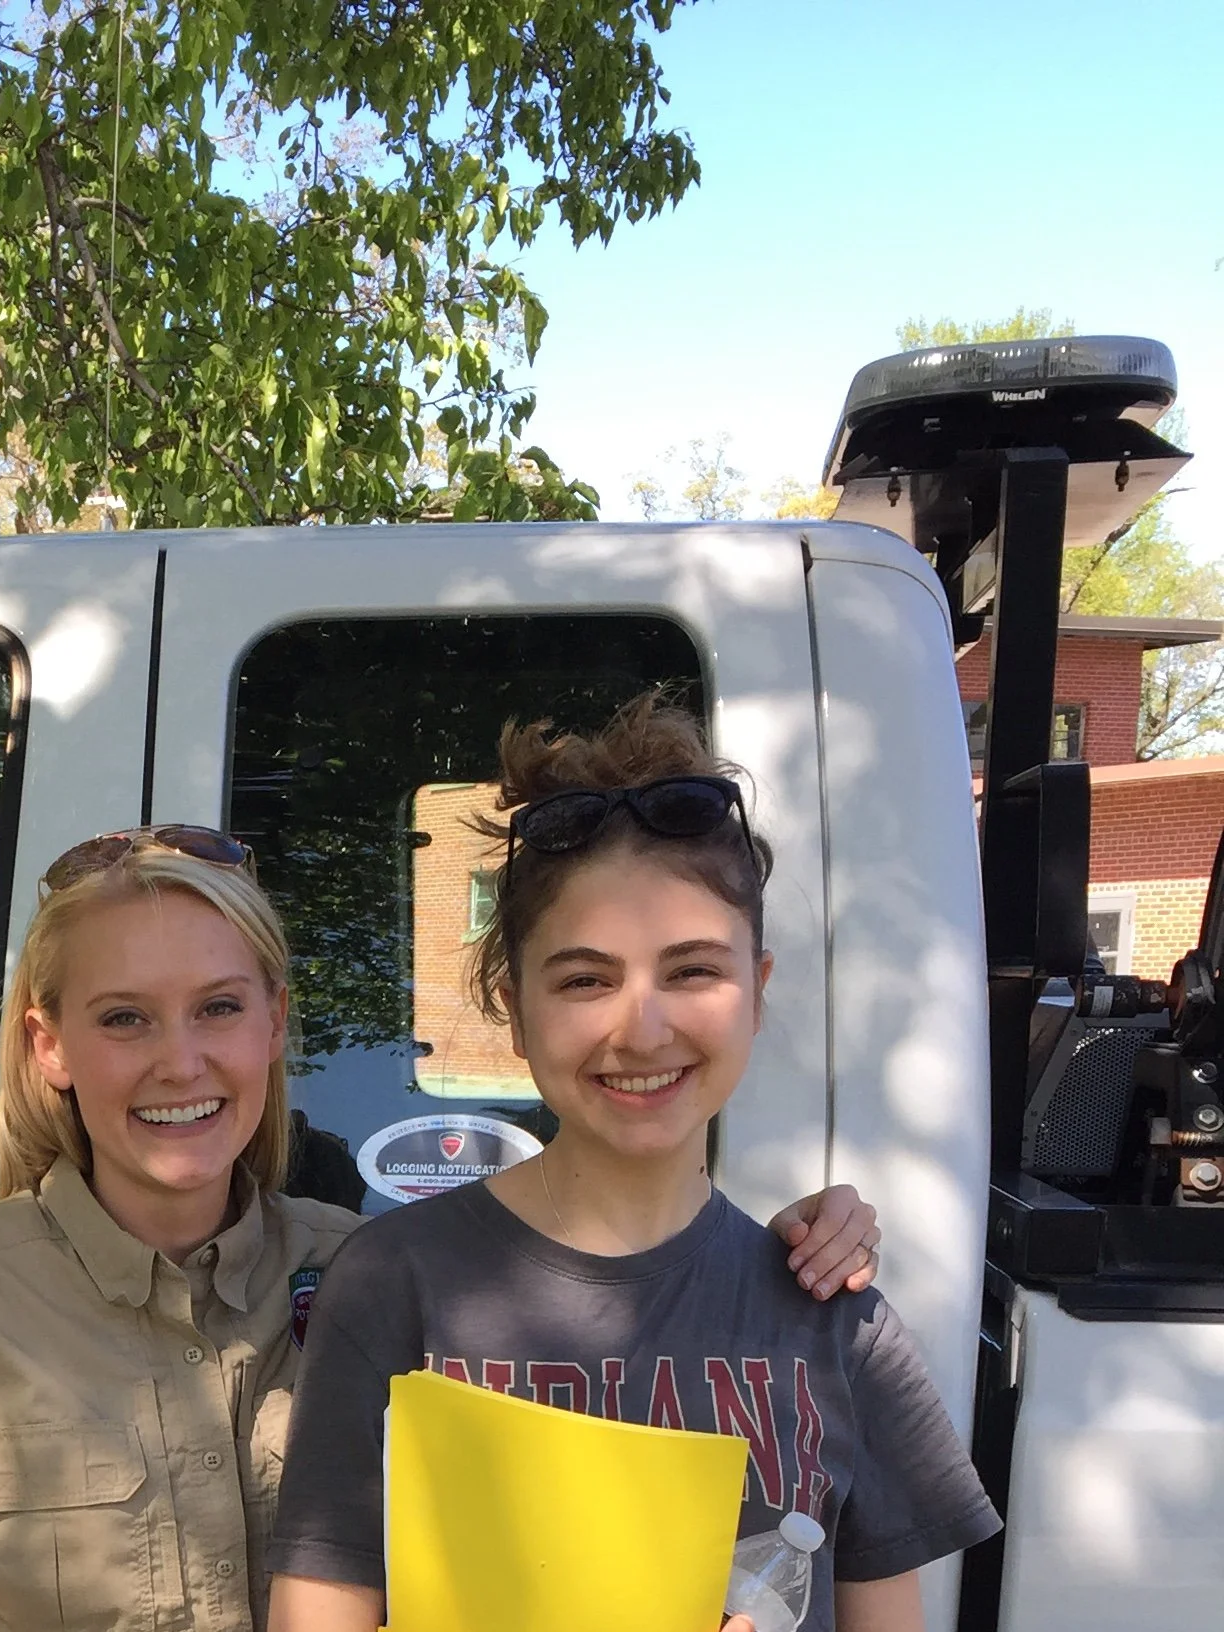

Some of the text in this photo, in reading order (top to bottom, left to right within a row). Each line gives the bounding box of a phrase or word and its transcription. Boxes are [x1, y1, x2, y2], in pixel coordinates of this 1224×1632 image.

[991, 388, 1047, 401] WHELEN
[386, 1163, 511, 1175] LOGGING NOTIFICATIO
[424, 1353, 834, 1516] IANA
